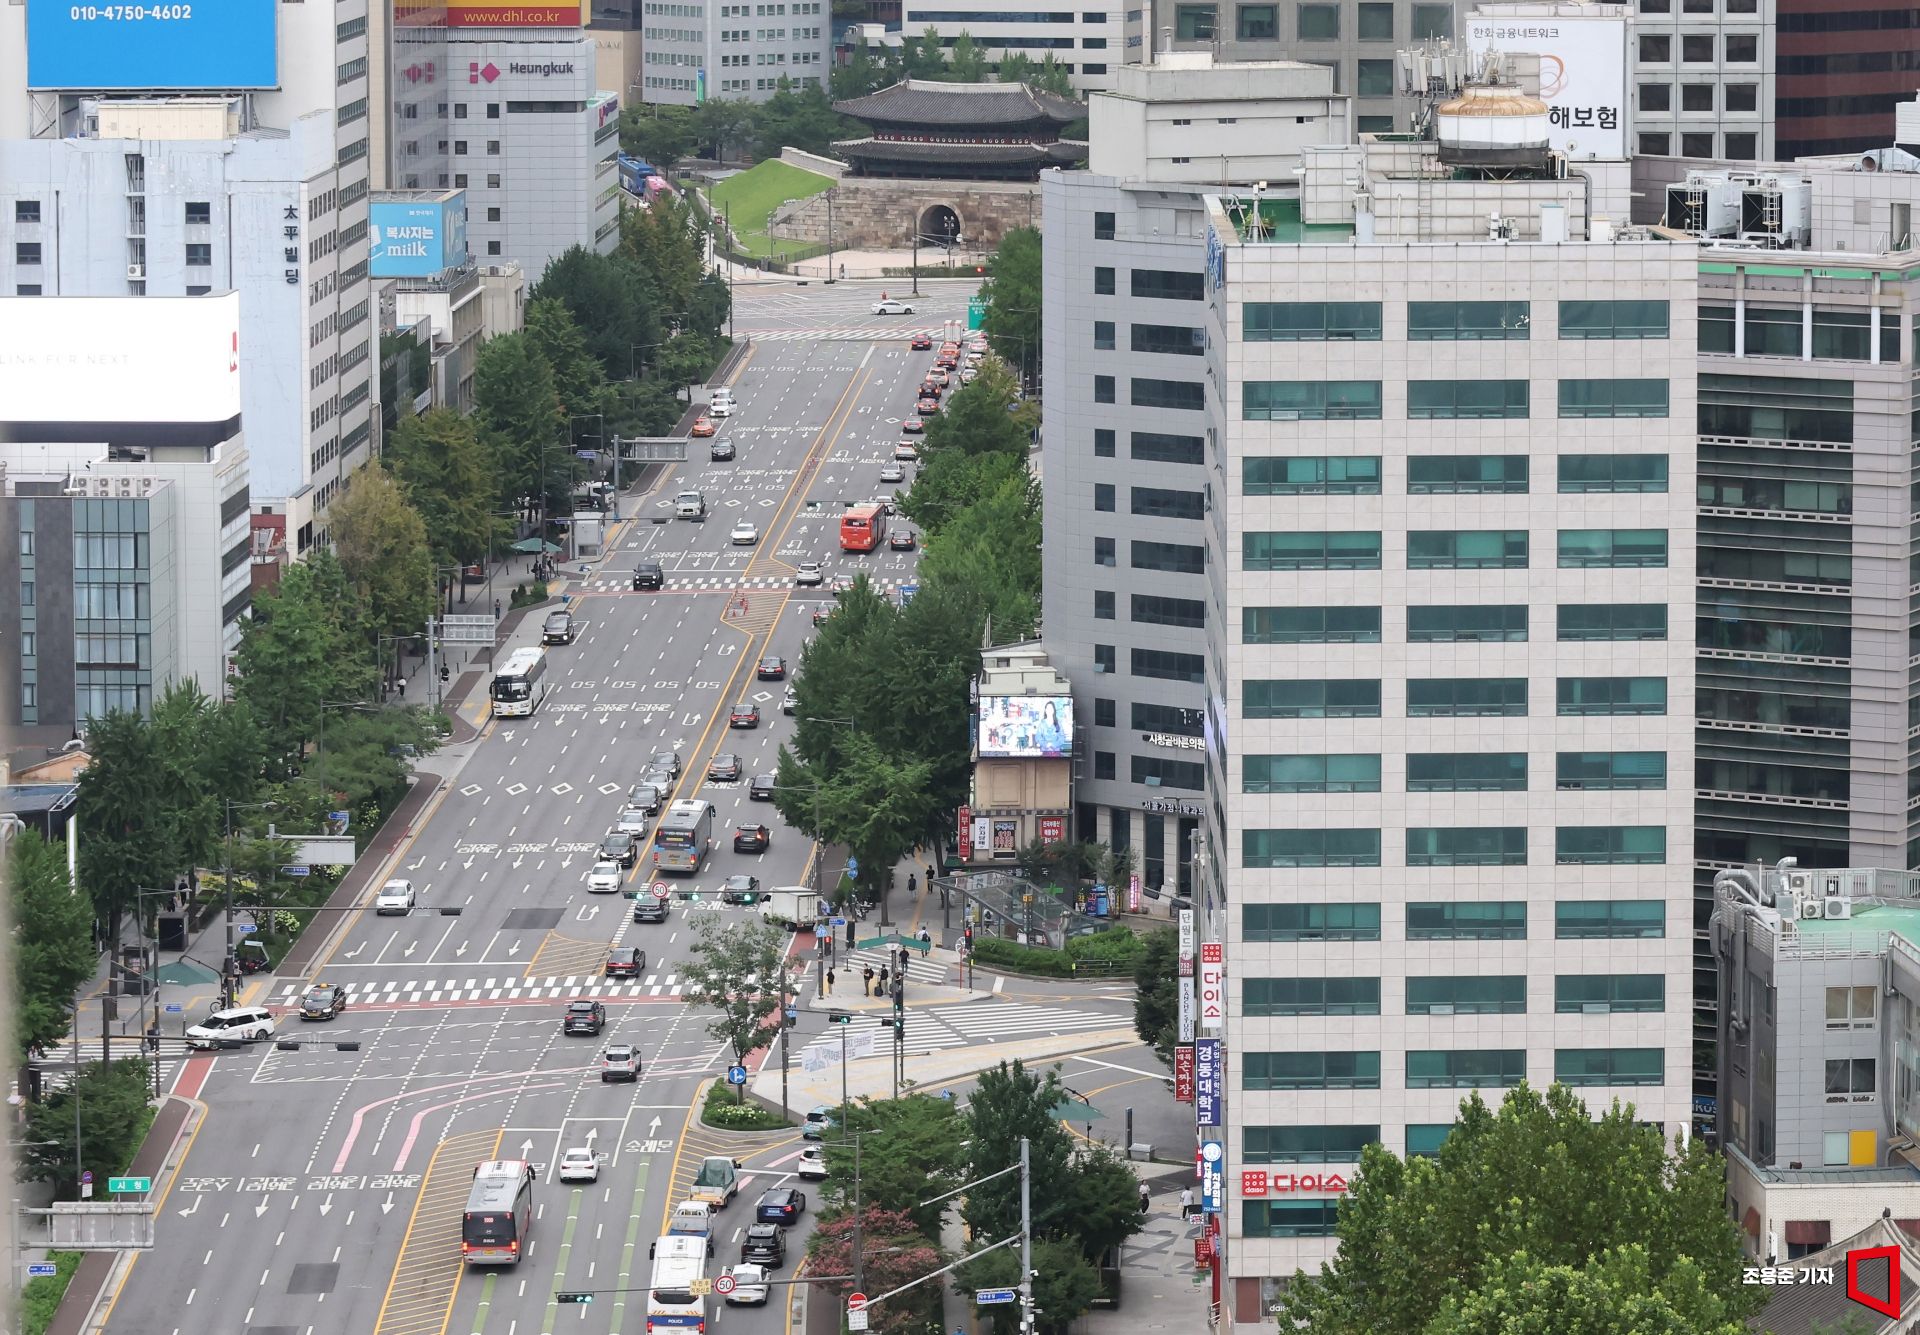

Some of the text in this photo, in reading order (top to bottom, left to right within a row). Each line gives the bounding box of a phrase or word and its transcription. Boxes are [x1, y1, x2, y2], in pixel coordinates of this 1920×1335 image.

[70, 4, 192, 20] 010-4750-4602
[464, 10, 560, 22] www.dhl.co.kr
[509, 61, 574, 77] Heungkuk
[386, 226, 434, 240] 복사지는
[283, 204, 299, 284] 太平빌딩
[387, 240, 428, 257] miilk
[961, 816, 969, 846] 부동산
[655, 885, 665, 894] 50
[1181, 912, 1192, 948] 단월드
[1203, 971, 1221, 1018] 다이소
[1197, 1045, 1213, 1124] 경동대학교
[624, 1139, 674, 1153] 숭례문
[1273, 1173, 1348, 1192] 다이소
[719, 1280, 732, 1290] 50
